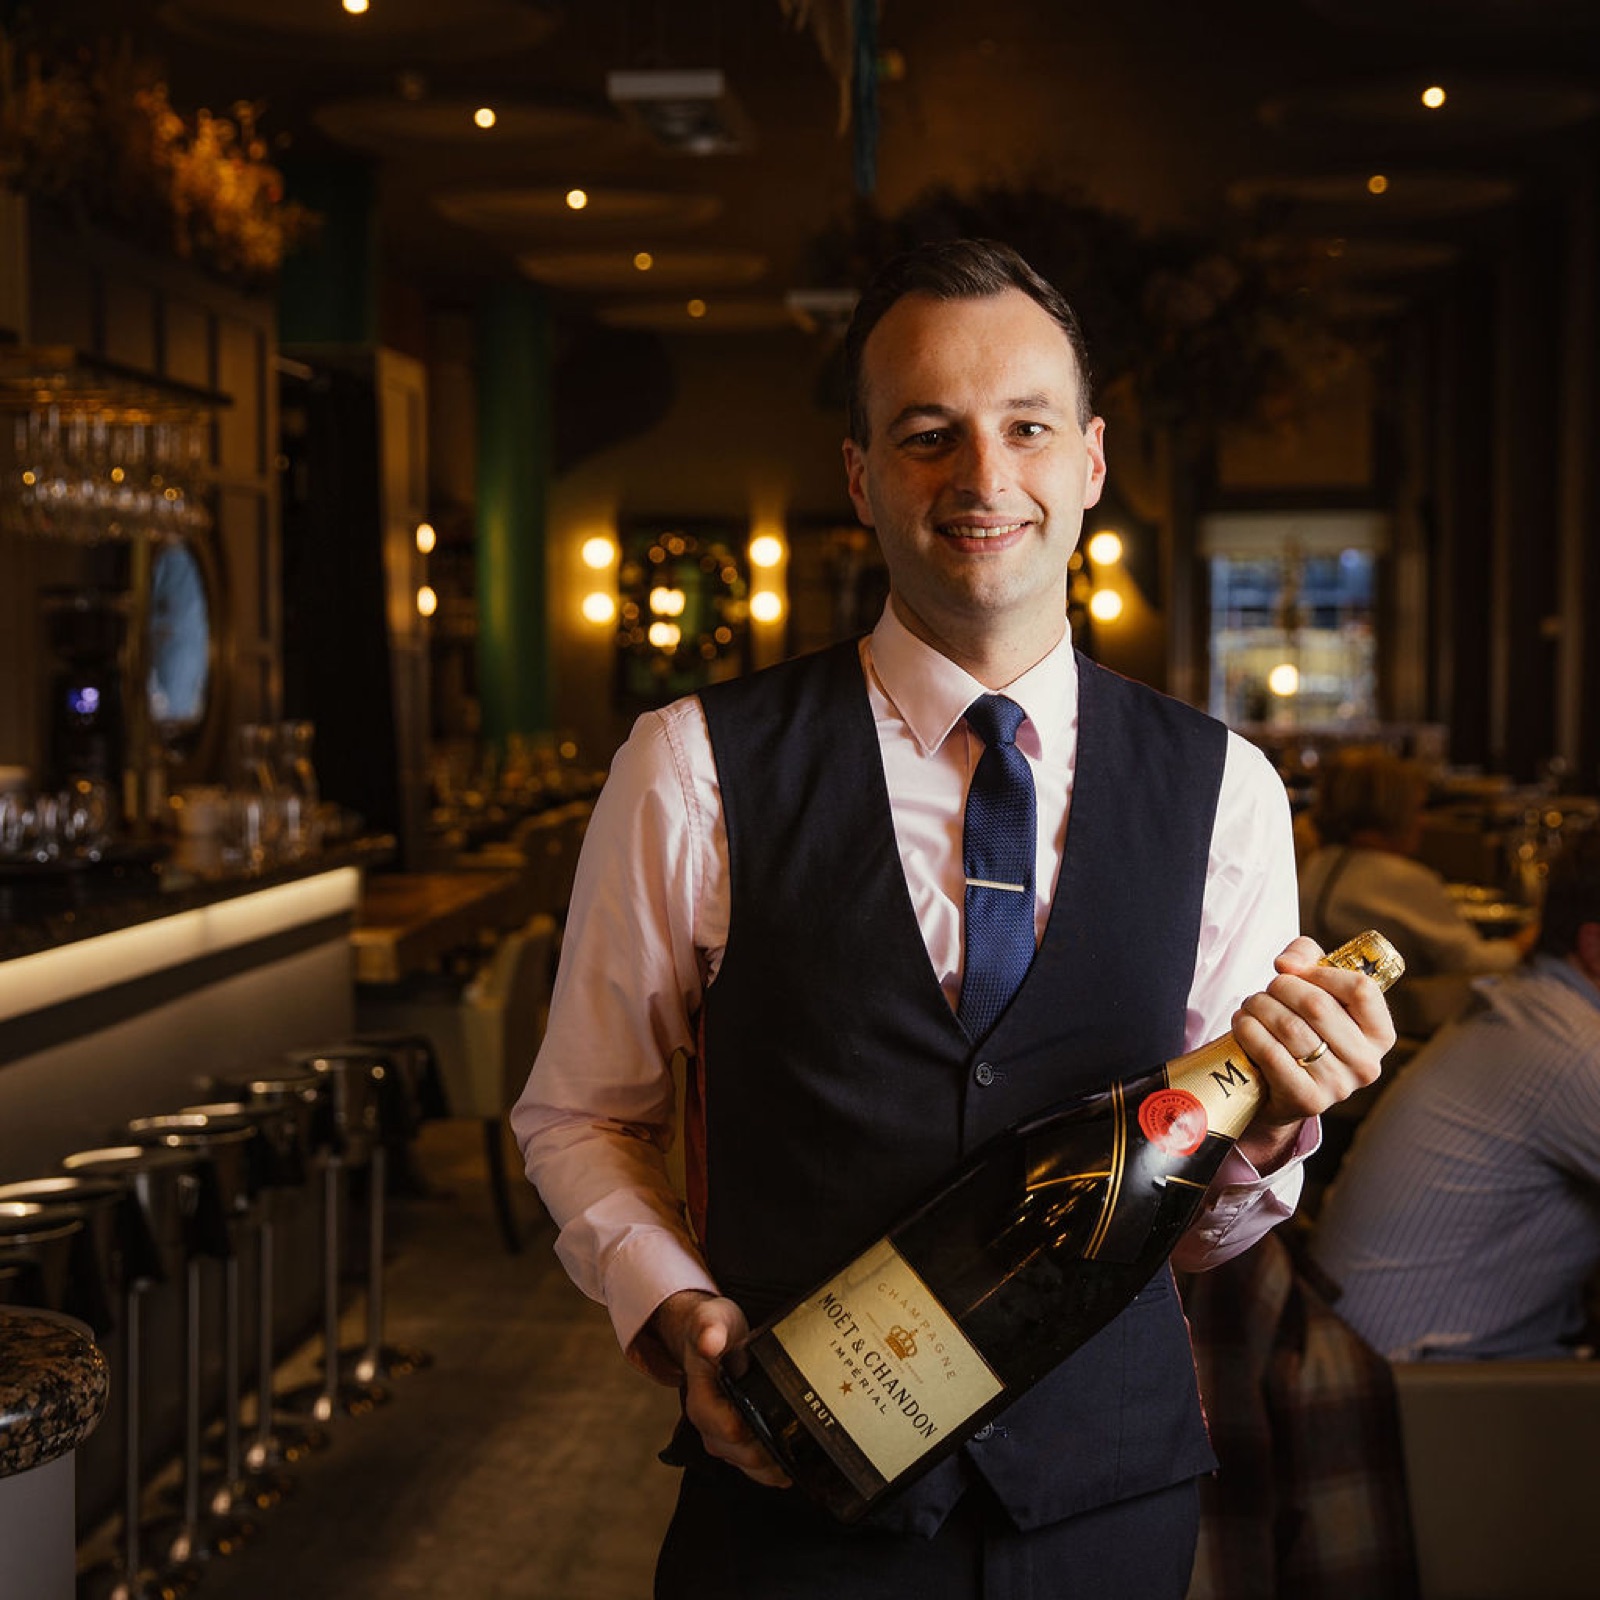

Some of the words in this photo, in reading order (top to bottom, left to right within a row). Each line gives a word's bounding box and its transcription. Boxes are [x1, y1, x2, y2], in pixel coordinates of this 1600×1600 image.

[1209, 1058, 1251, 1099] M
[818, 1291, 860, 1339] MOËT
[851, 1338, 865, 1354] &
[863, 1350, 938, 1440] CHANDON
[877, 1282, 956, 1381] CHAMPAGNE
[804, 1391, 835, 1429] BRUT
[829, 1339, 888, 1415] IMPÉRIAL
